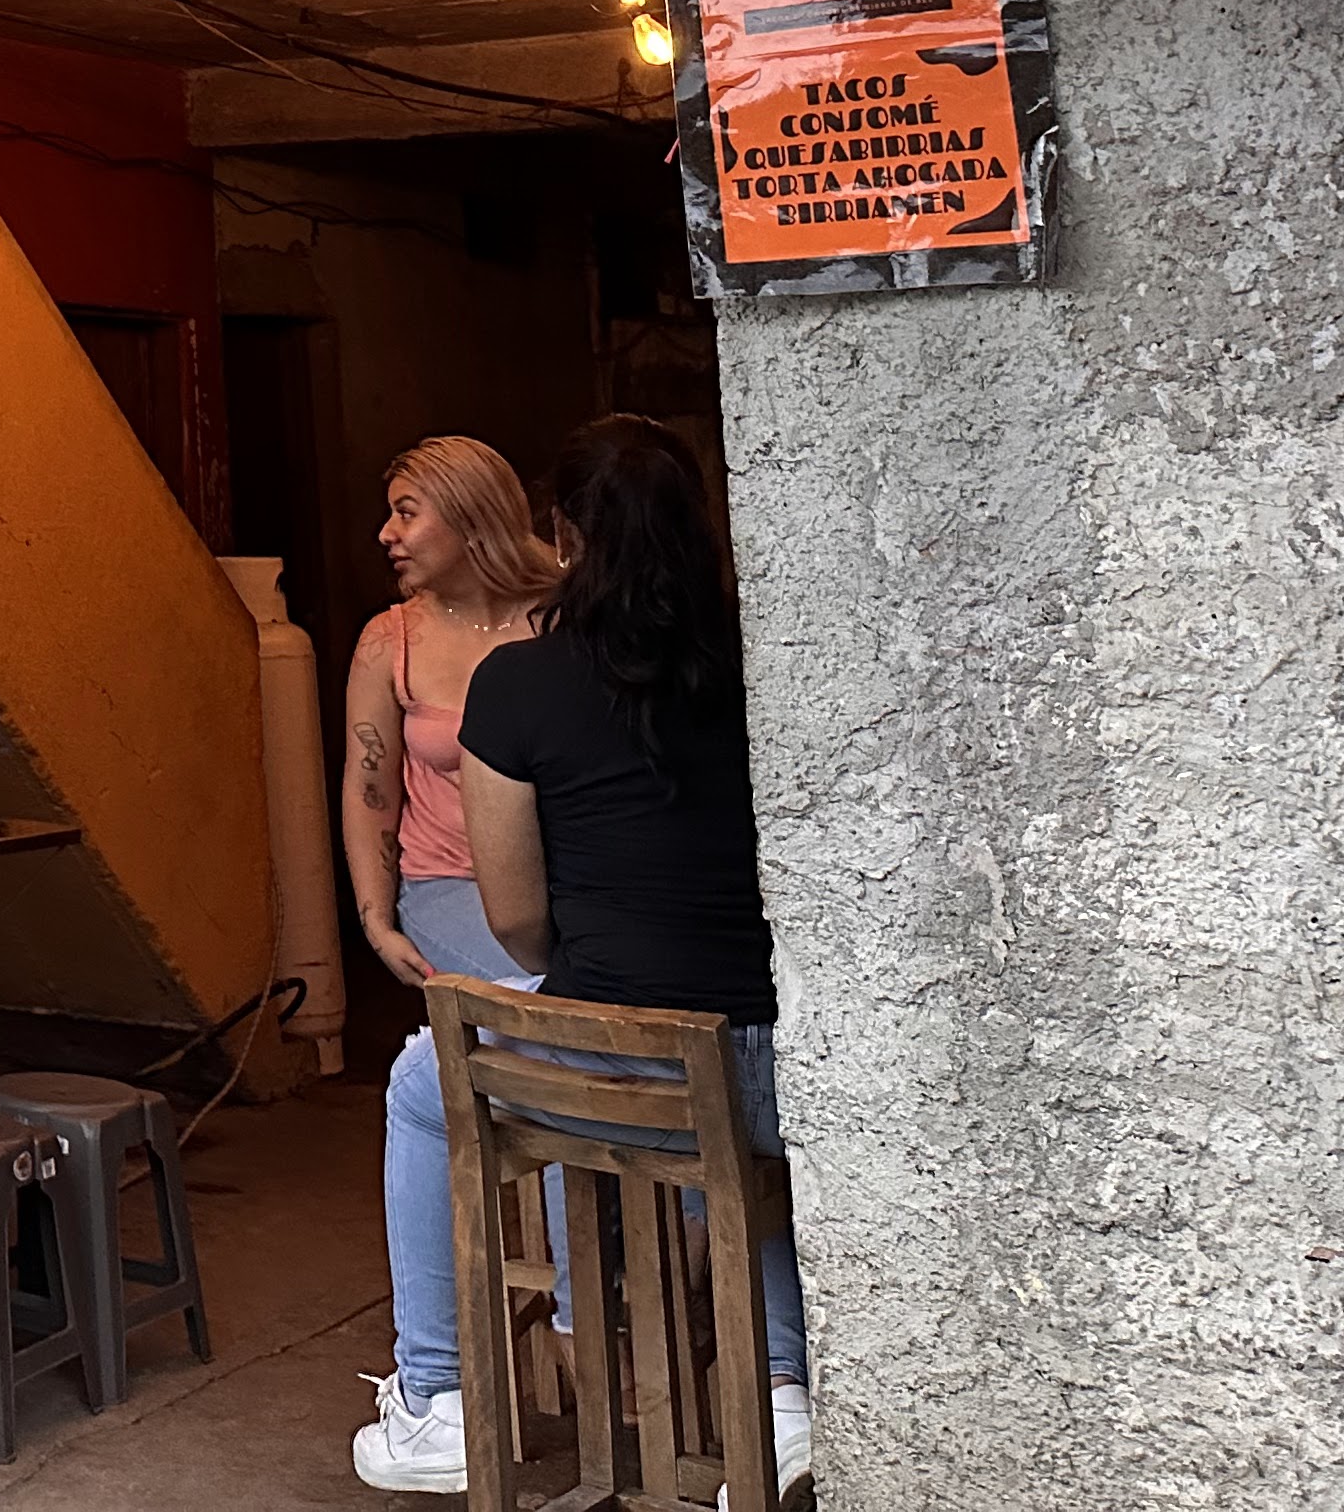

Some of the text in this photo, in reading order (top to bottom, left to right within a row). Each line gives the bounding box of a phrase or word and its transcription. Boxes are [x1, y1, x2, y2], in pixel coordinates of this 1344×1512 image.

[800, 73, 908, 106] TACOS
[780, 94, 941, 138] CONSOMÉ
[744, 126, 985, 170] QUESABIRRIAS
[732, 156, 1008, 200] TORTA AHOGADA
[776, 189, 966, 226] BIRRIAMEN
